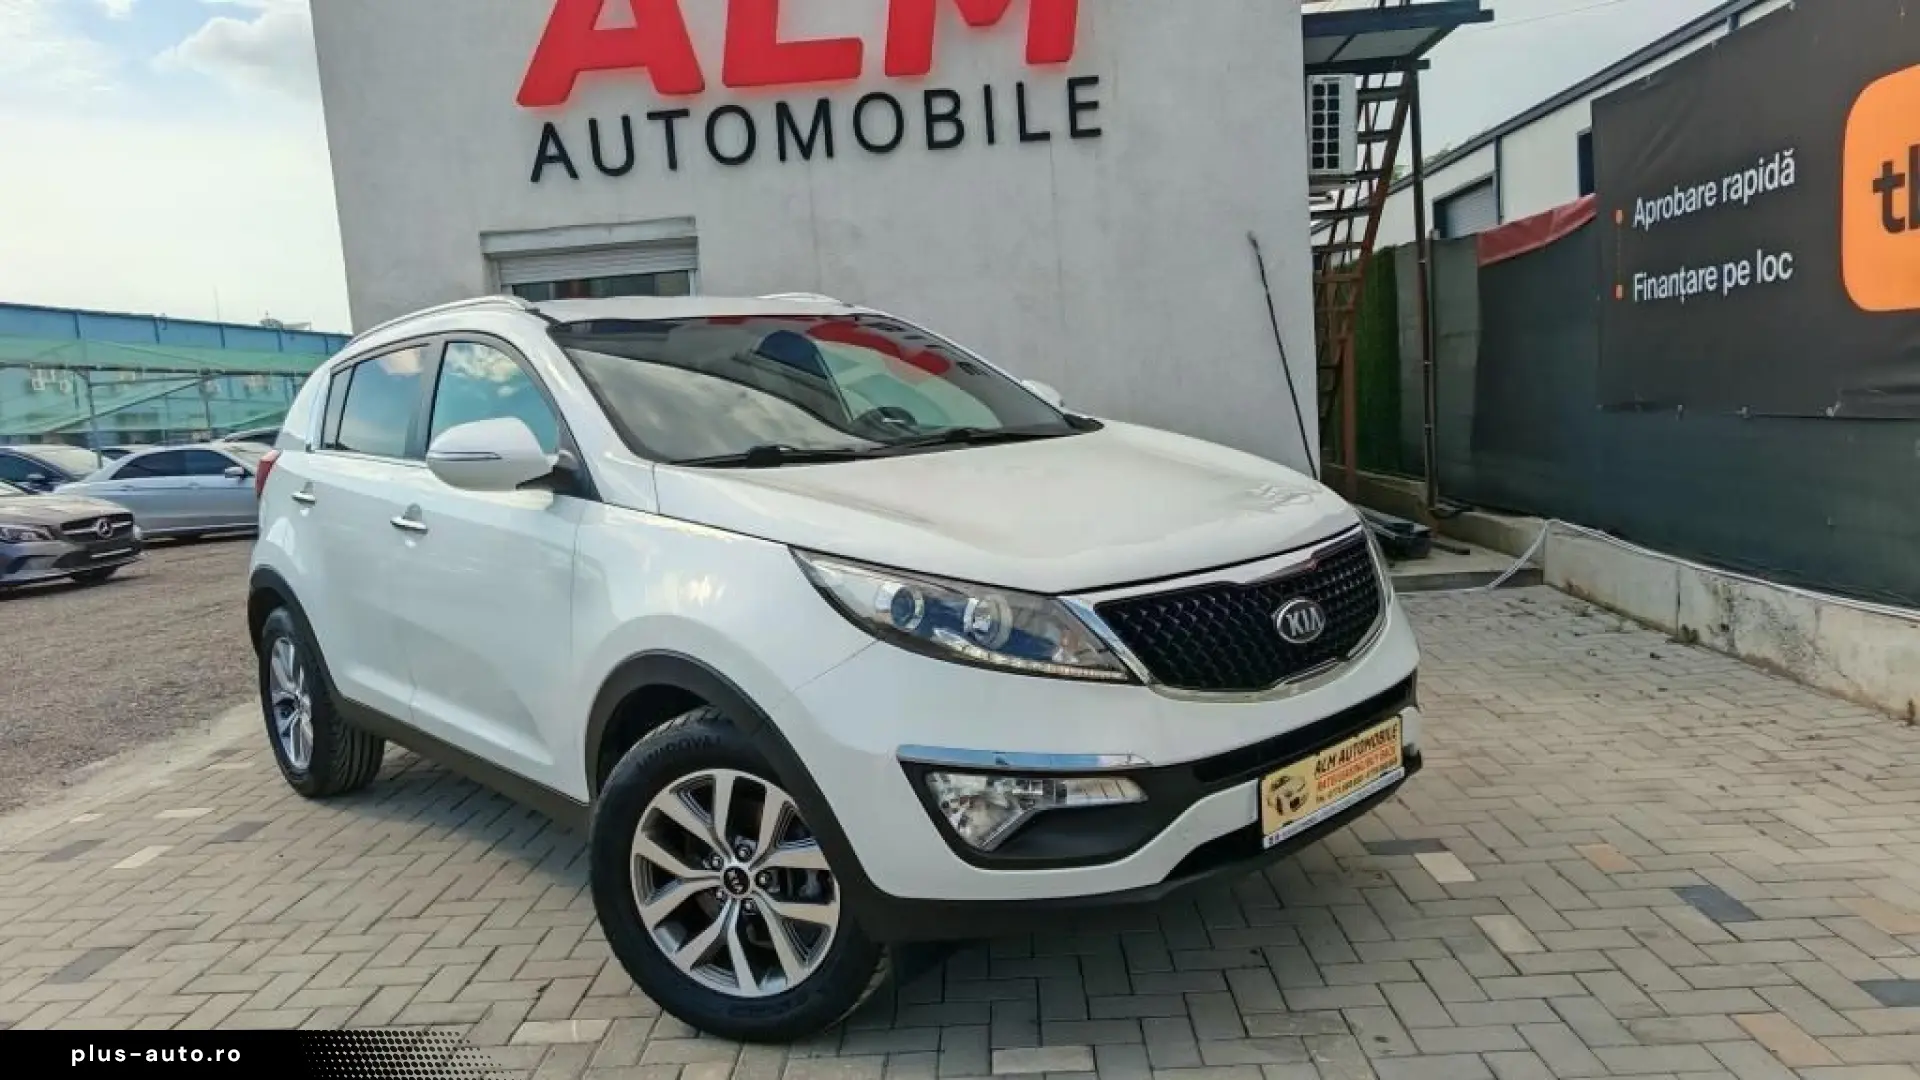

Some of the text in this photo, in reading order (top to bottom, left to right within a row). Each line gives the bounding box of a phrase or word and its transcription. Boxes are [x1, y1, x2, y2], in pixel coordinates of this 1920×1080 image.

[516, 0, 1079, 107] ALM
[530, 75, 1104, 183] AUTOMOBILE
[1632, 148, 1796, 231] Aprobare rapidă
[1633, 249, 1794, 304] Finanțare pe loc
[1285, 607, 1322, 637] KIA
